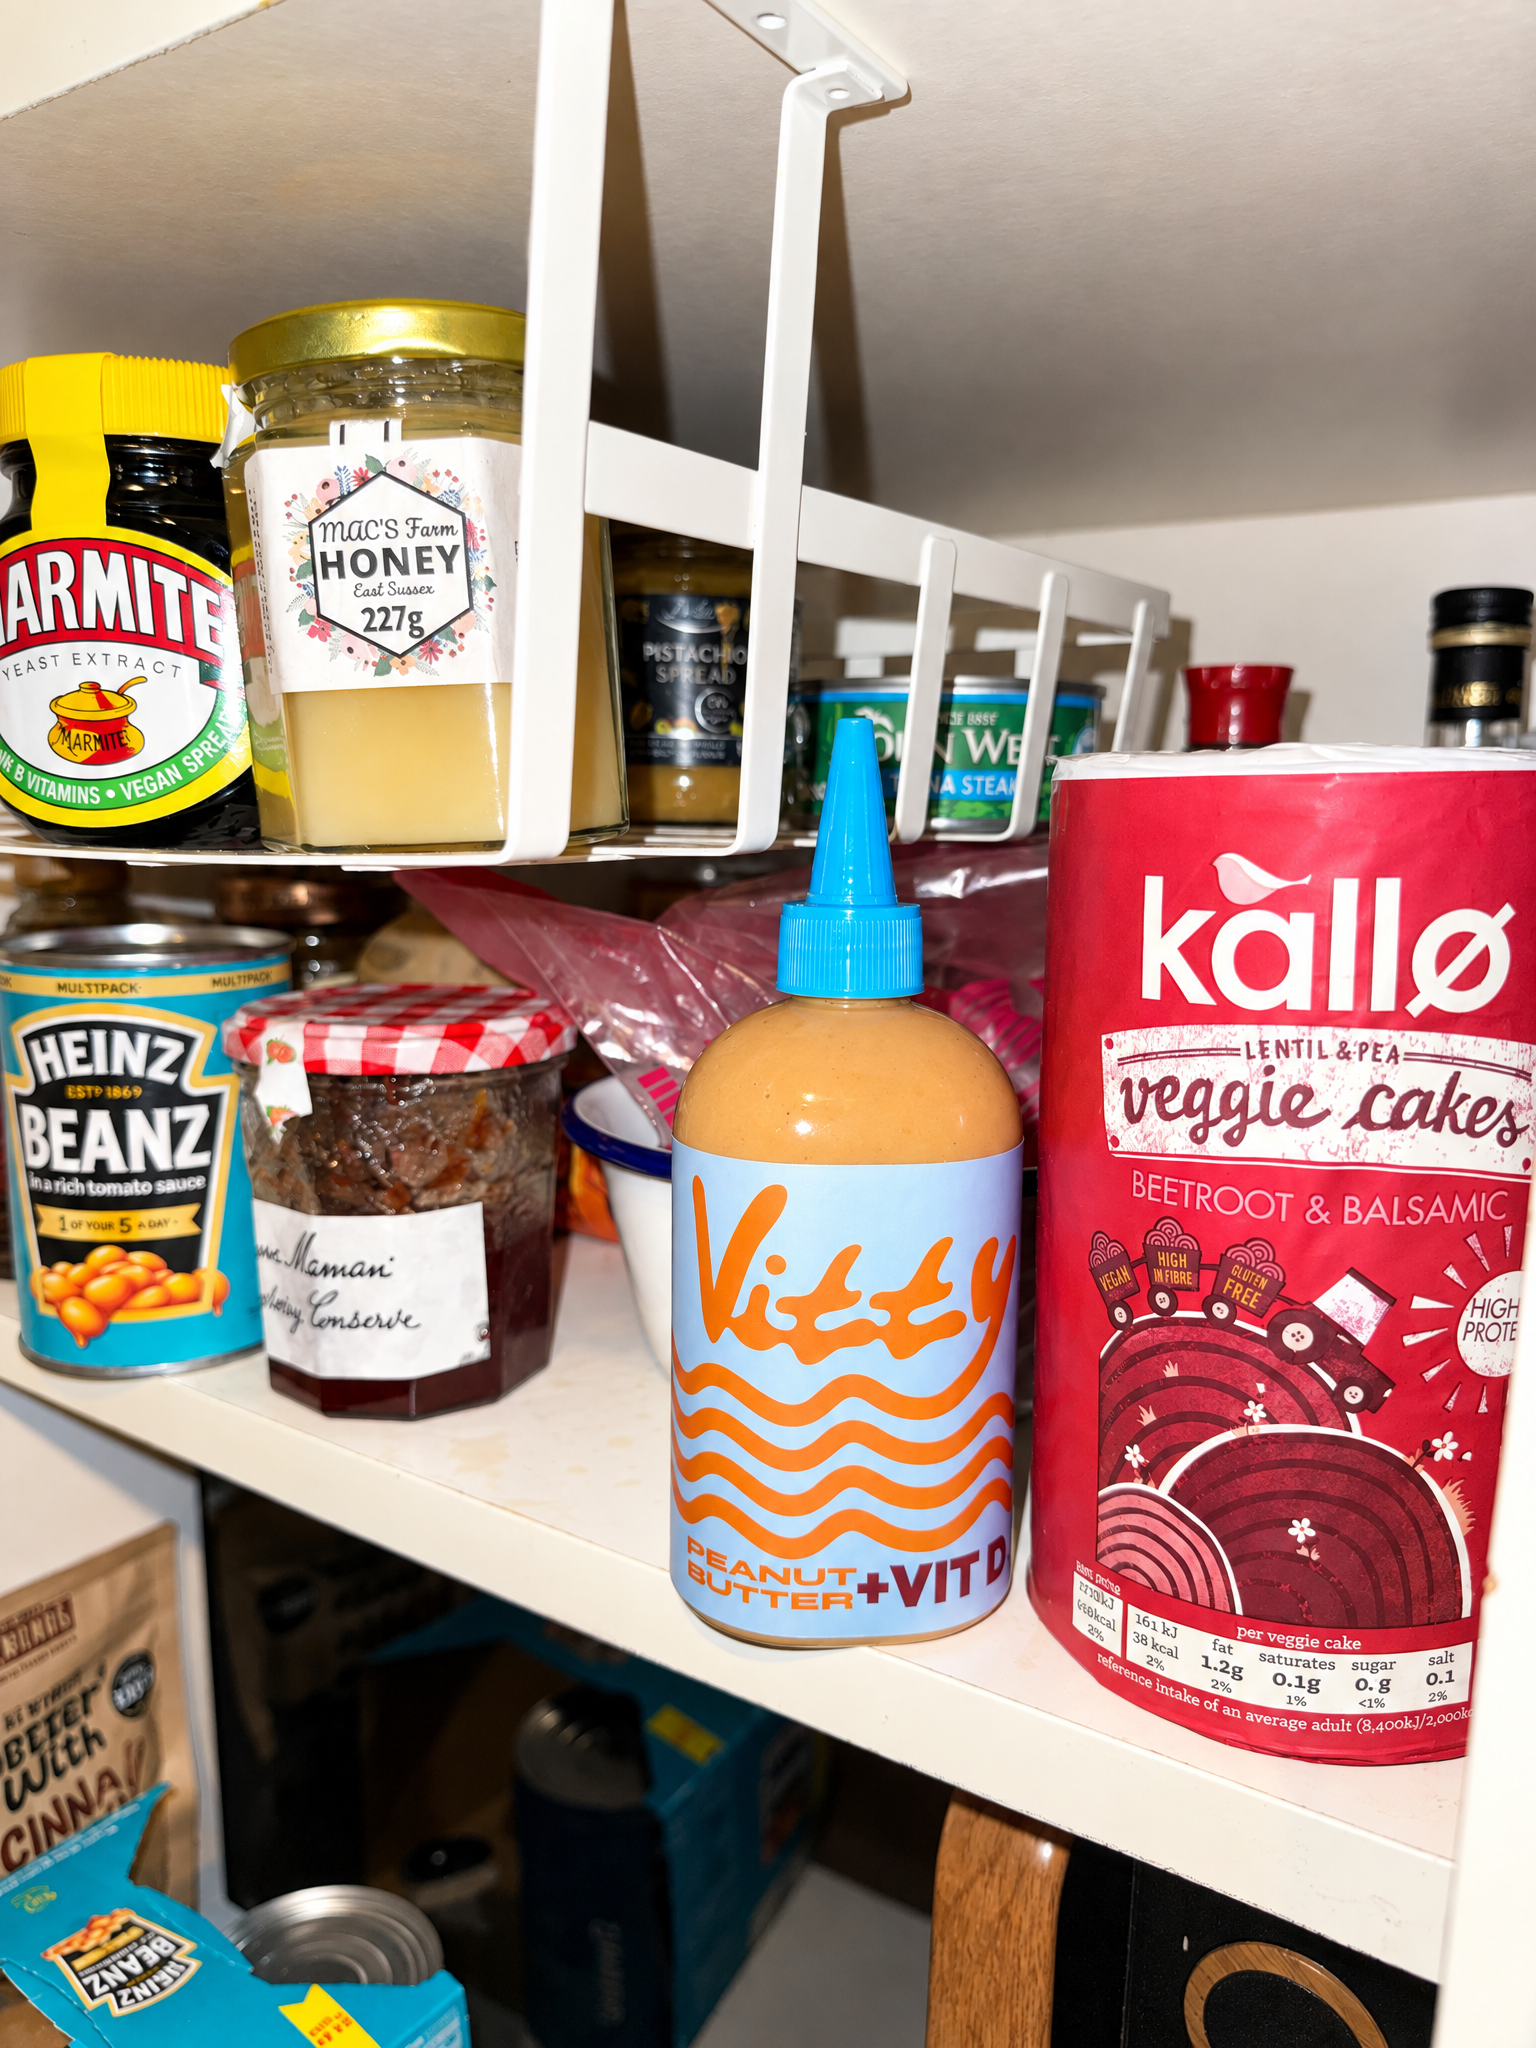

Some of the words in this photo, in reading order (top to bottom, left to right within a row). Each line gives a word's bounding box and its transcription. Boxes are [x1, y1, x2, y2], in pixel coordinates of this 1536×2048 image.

[405, 517, 459, 539] Farm
[319, 544, 461, 581] HONEY
[353, 582, 384, 598] East
[387, 580, 435, 597] Sussex
[0, 549, 225, 660] ARMITE
[360, 606, 425, 639] 227g
[642, 641, 747, 665] PISTACHIO
[2, 655, 59, 681] YEAST
[72, 653, 182, 678] EXTRACT
[655, 663, 737, 685] SPREAD
[55, 726, 130, 757] MARMITE
[961, 728, 1061, 766] WET
[15, 765, 25, 782] B
[27, 771, 101, 804] VITAMINS
[119, 764, 184, 801] VEGAN
[889, 773, 957, 795] TNA
[28, 1028, 185, 1085] HEINZ
[1245, 1038, 1329, 1060] LENTIL
[1120, 1064, 1332, 1148] veggie
[1342, 1071, 1530, 1149] cakes
[19, 1103, 211, 1174] BEANZ
[29, 1174, 42, 1192] in
[42, 1179, 52, 1193] a
[53, 1177, 85, 1196] rich
[86, 1179, 153, 1197] tomato
[154, 1175, 207, 1194] sauce
[1131, 1169, 1294, 1222] BEETROOT
[1305, 1198, 1332, 1225] &
[1343, 1190, 1508, 1227] BALSAMIC
[59, 1215, 68, 1232] 1
[87, 1220, 115, 1231] YOUR
[119, 1217, 132, 1234] 5
[692, 1174, 1017, 1368] Vitty
[1157, 1251, 1188, 1268] HIGH
[1099, 1264, 1132, 1292] VEGAN
[1153, 1268, 1164, 1283] IN
[1165, 1269, 1193, 1285] FIBRE
[1231, 1264, 1268, 1291] GLUTEN
[1222, 1277, 1263, 1310] FREE
[309, 1289, 422, 1331] Conserve
[1470, 1297, 1521, 1319] HIGH
[1462, 1320, 1518, 1343] PROTE
[687, 1534, 857, 1587] PEANUT
[986, 1534, 1007, 1587] D
[687, 1558, 854, 1612] BUTTER
[1087, 1624, 1105, 1642] 2%
[1135, 1613, 1158, 1632] 161
[1161, 1621, 1178, 1639] kJ
[1236, 1626, 1264, 1641] per
[1267, 1632, 1320, 1650] veggie
[1324, 1635, 1362, 1650] cake
[1133, 1631, 1148, 1646] 38
[1151, 1637, 1179, 1660] kcal
[1212, 1638, 1234, 1655] fat
[1146, 1654, 1165, 1672] 2%
[1201, 1655, 1244, 1681] 1.2g
[1259, 1652, 1336, 1671] saturates
[1351, 1660, 1397, 1674] sugar
[1428, 1651, 1455, 1666] salt
[1097, 1652, 1153, 1689] reference
[1155, 1678, 1200, 1707] intake
[1203, 1699, 1220, 1712] of
[1222, 1706, 1242, 1719] an
[1245, 1710, 1307, 1732] average
[1311, 1718, 1352, 1732] adult
[1356, 1706, 1473, 1735] (8,400kJ/2,000kc
[1210, 1678, 1232, 1694] 2%
[1272, 1672, 1321, 1693] 0.1g
[1286, 1695, 1307, 1707] 1%
[1358, 1698, 1386, 1708] <1%
[1428, 1690, 1448, 1703] 2%
[81, 1935, 177, 1997] BEANZ
